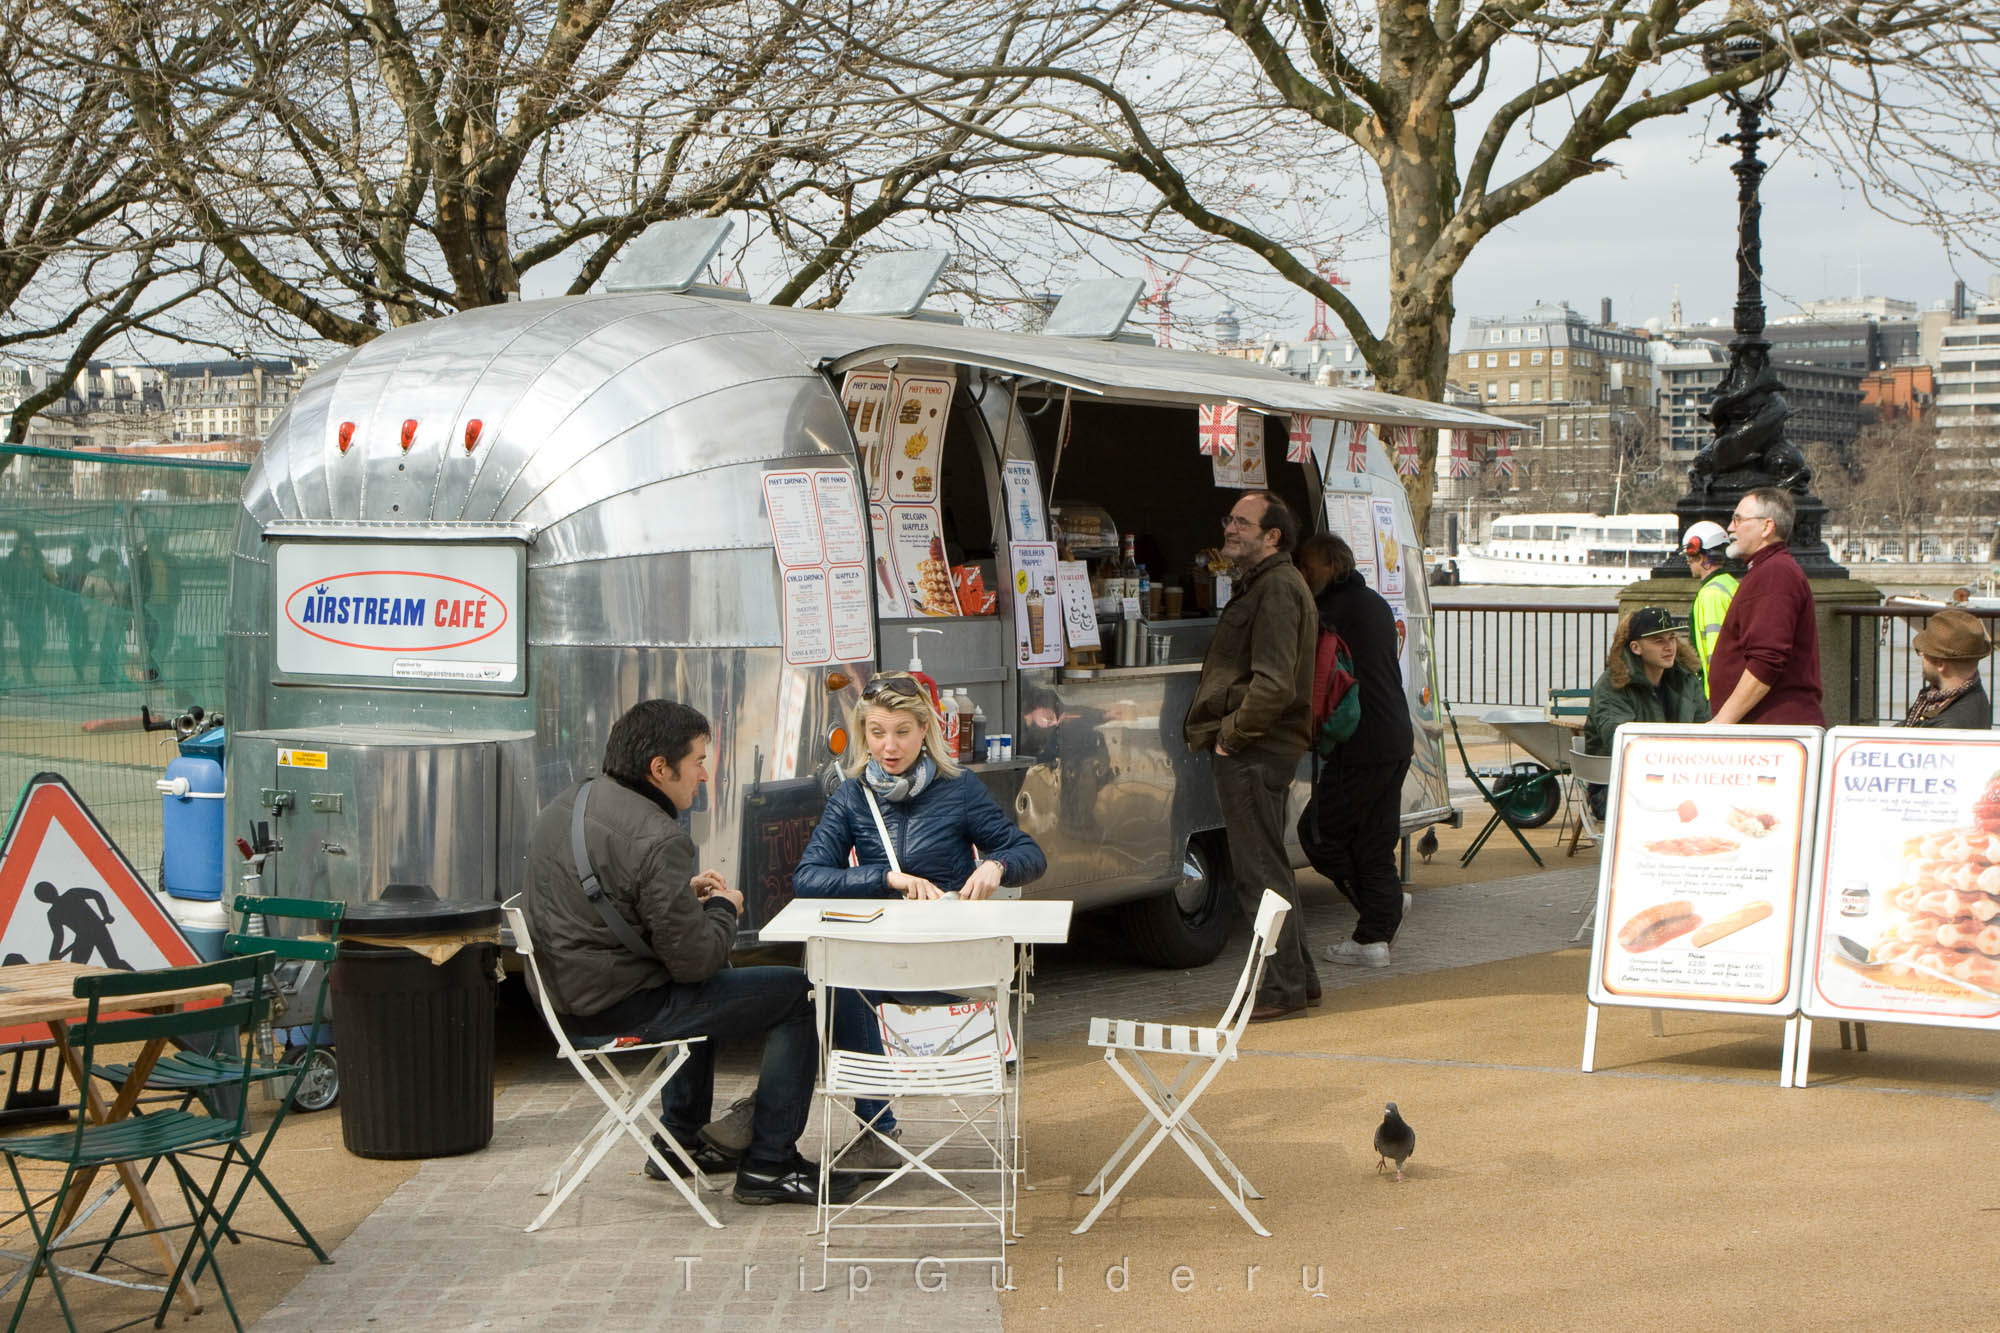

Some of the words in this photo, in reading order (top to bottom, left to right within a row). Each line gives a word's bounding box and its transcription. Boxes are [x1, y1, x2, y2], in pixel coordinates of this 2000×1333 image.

[303, 596, 426, 626] AIRSTREAM
[434, 594, 488, 629] CAFÉ
[1644, 751, 1785, 768] CURRYWURST
[1850, 751, 1956, 769] BELGIAN
[1672, 772, 1690, 785] IS
[1844, 775, 1958, 795] WAFFLES
